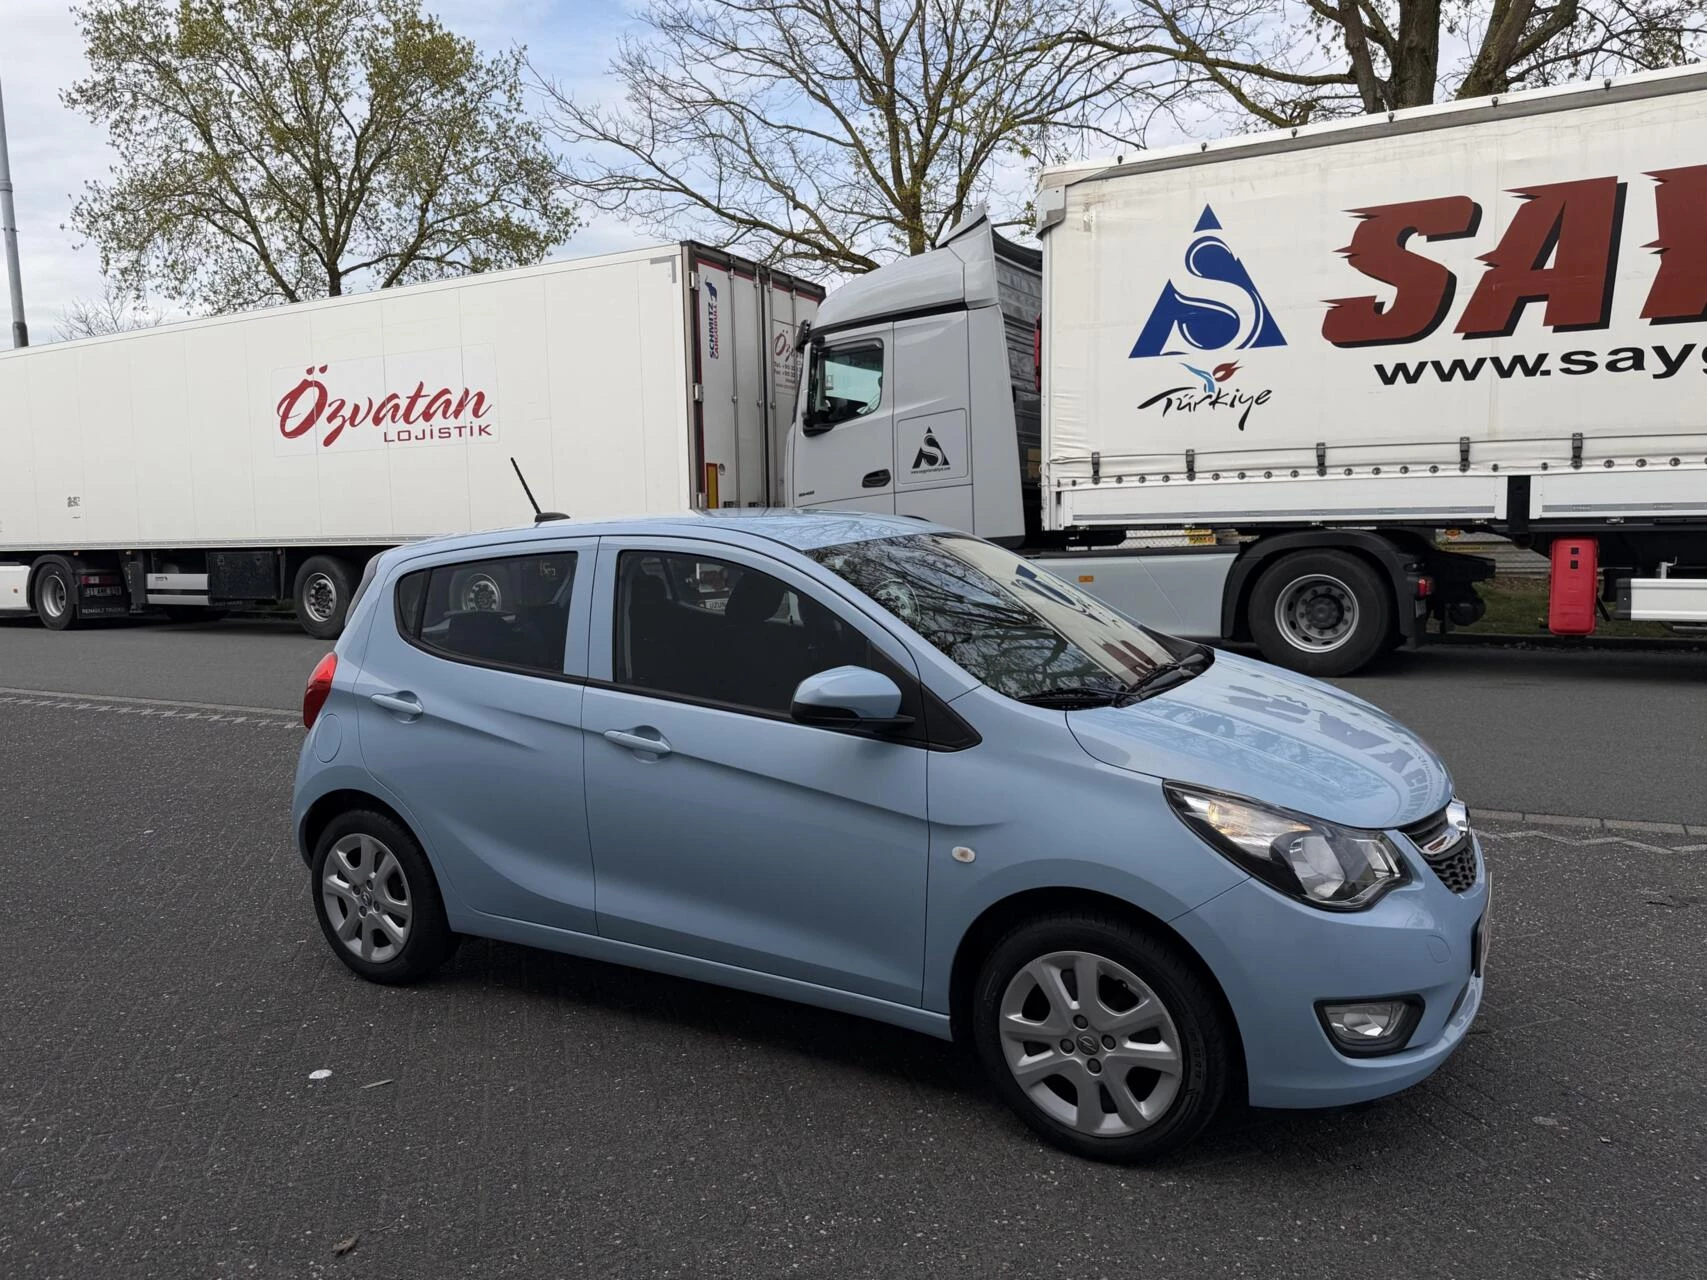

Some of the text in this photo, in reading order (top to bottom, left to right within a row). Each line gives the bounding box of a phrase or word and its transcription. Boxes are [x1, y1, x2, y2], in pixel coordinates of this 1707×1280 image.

[1374, 342, 1707, 386] www.say
[277, 364, 493, 447] Özvatan
[1137, 382, 1272, 431] Türkiye
[384, 421, 493, 443] LOJİSTİK
